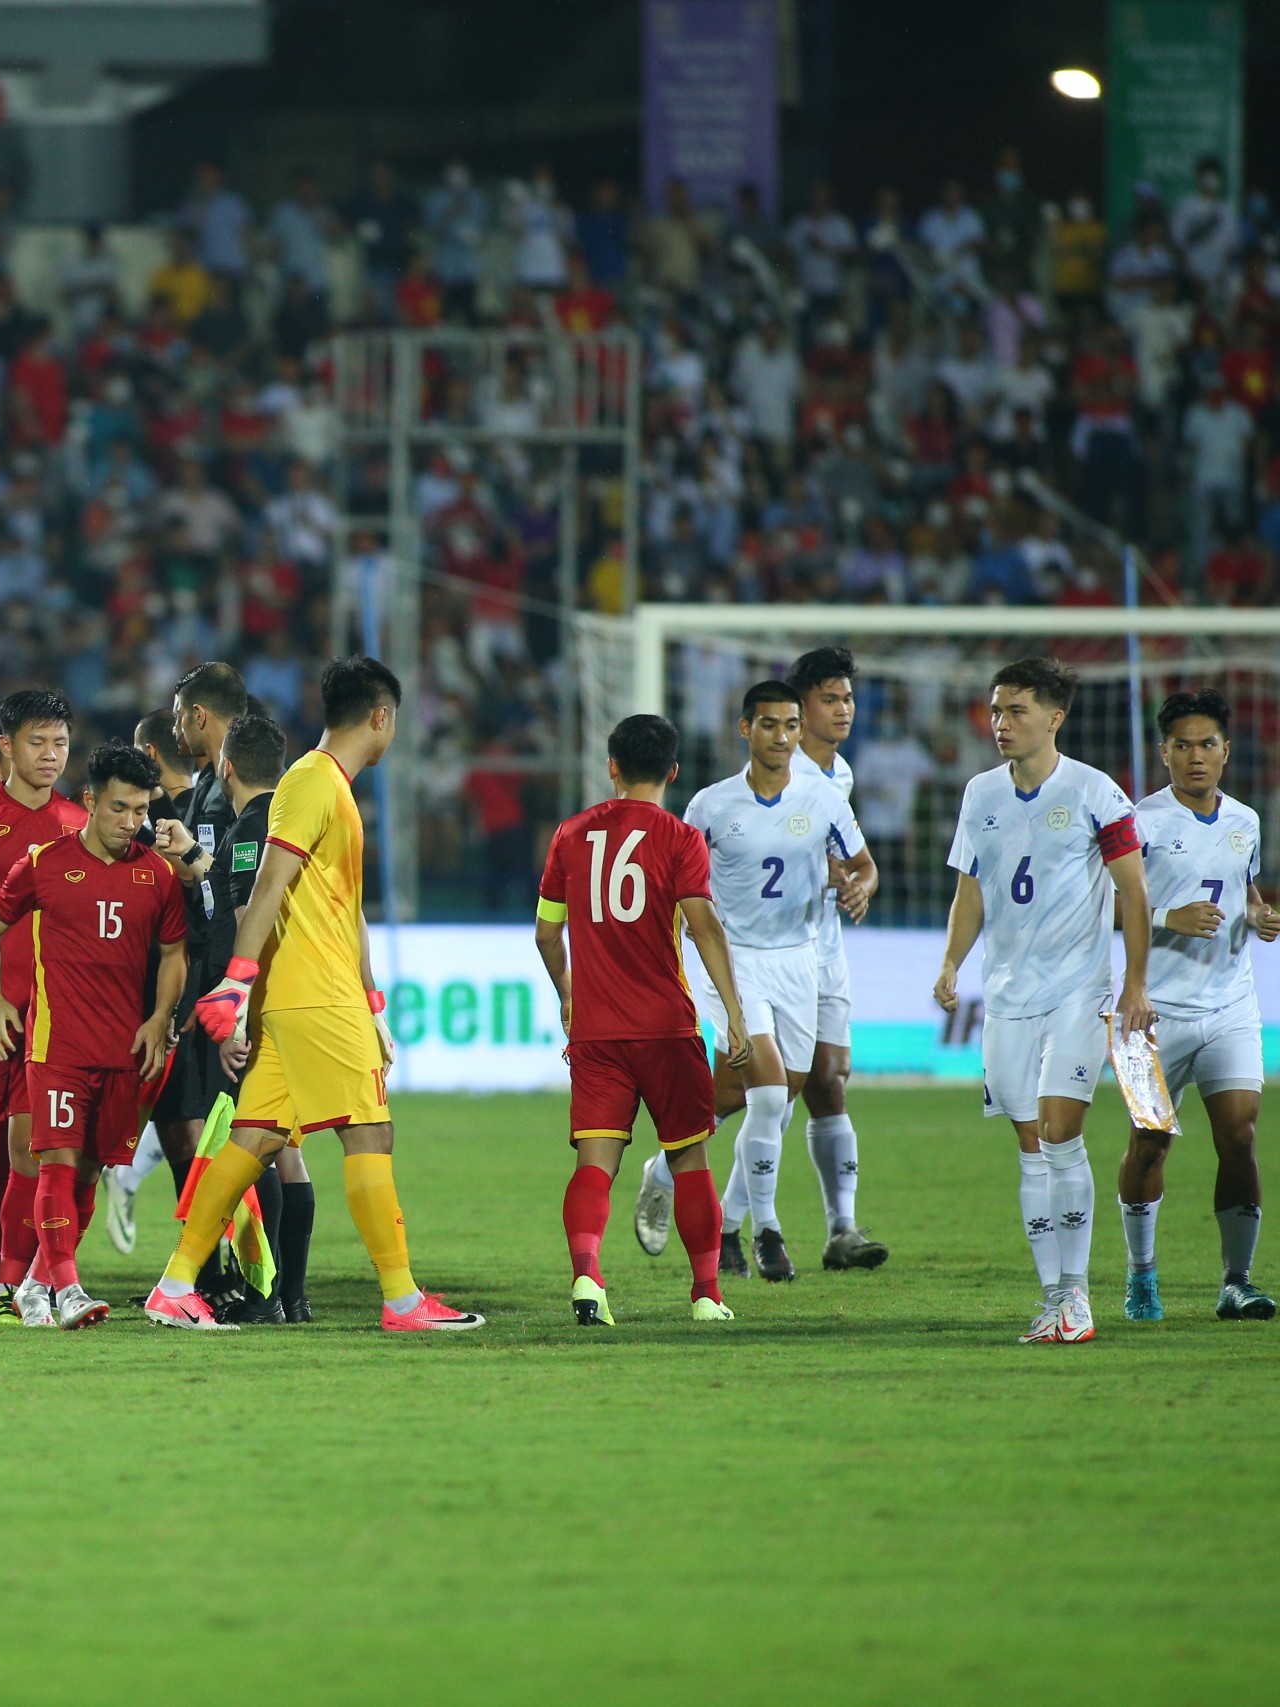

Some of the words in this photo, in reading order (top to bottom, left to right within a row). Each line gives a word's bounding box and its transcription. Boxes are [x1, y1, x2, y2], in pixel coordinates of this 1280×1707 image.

[586, 829, 647, 923] 16
[761, 856, 785, 899] 2
[1011, 855, 1034, 905] 6
[1201, 879, 1224, 905] 7
[96, 900, 124, 940] 15
[375, 979, 554, 1045] een.
[47, 1090, 75, 1128] 15
[1028, 1227, 1055, 1236] KELME
